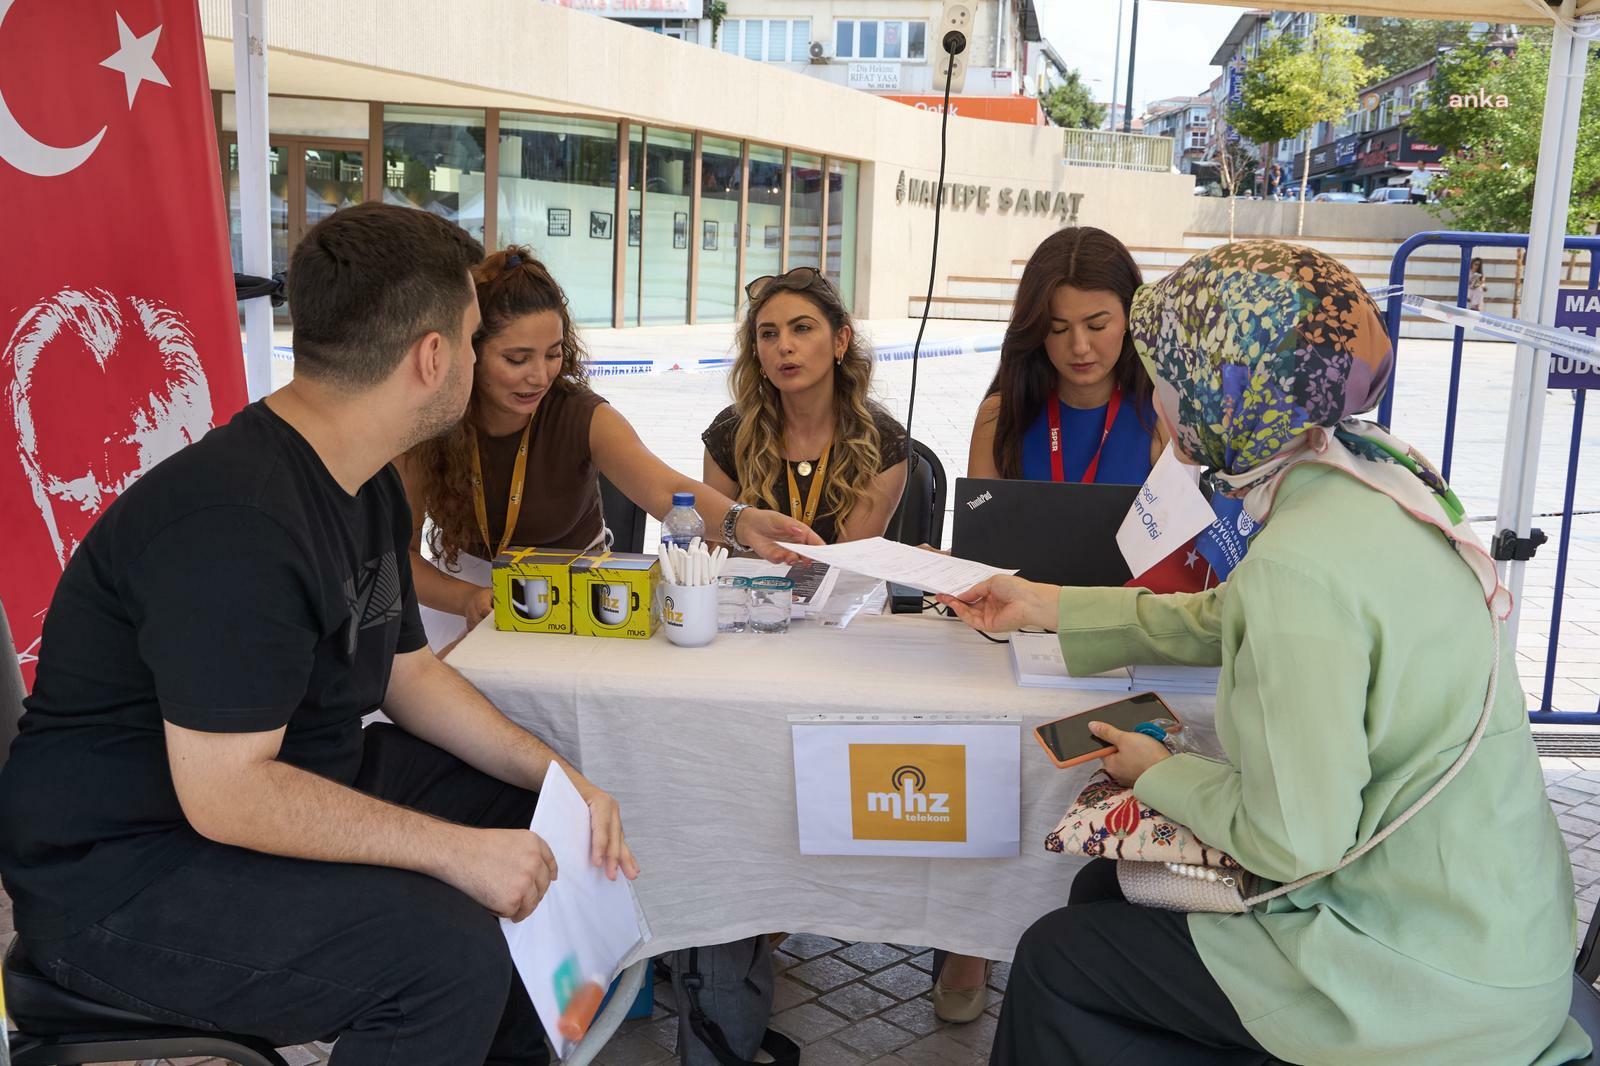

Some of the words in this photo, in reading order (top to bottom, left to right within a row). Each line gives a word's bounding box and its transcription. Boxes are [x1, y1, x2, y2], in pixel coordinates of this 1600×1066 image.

[999, 187, 1085, 218] SANAT
[966, 490, 993, 510] ThinkPad
[1142, 513, 1162, 540] Ofisi
[867, 778, 950, 819] mhz
[904, 813, 950, 822] telekom
